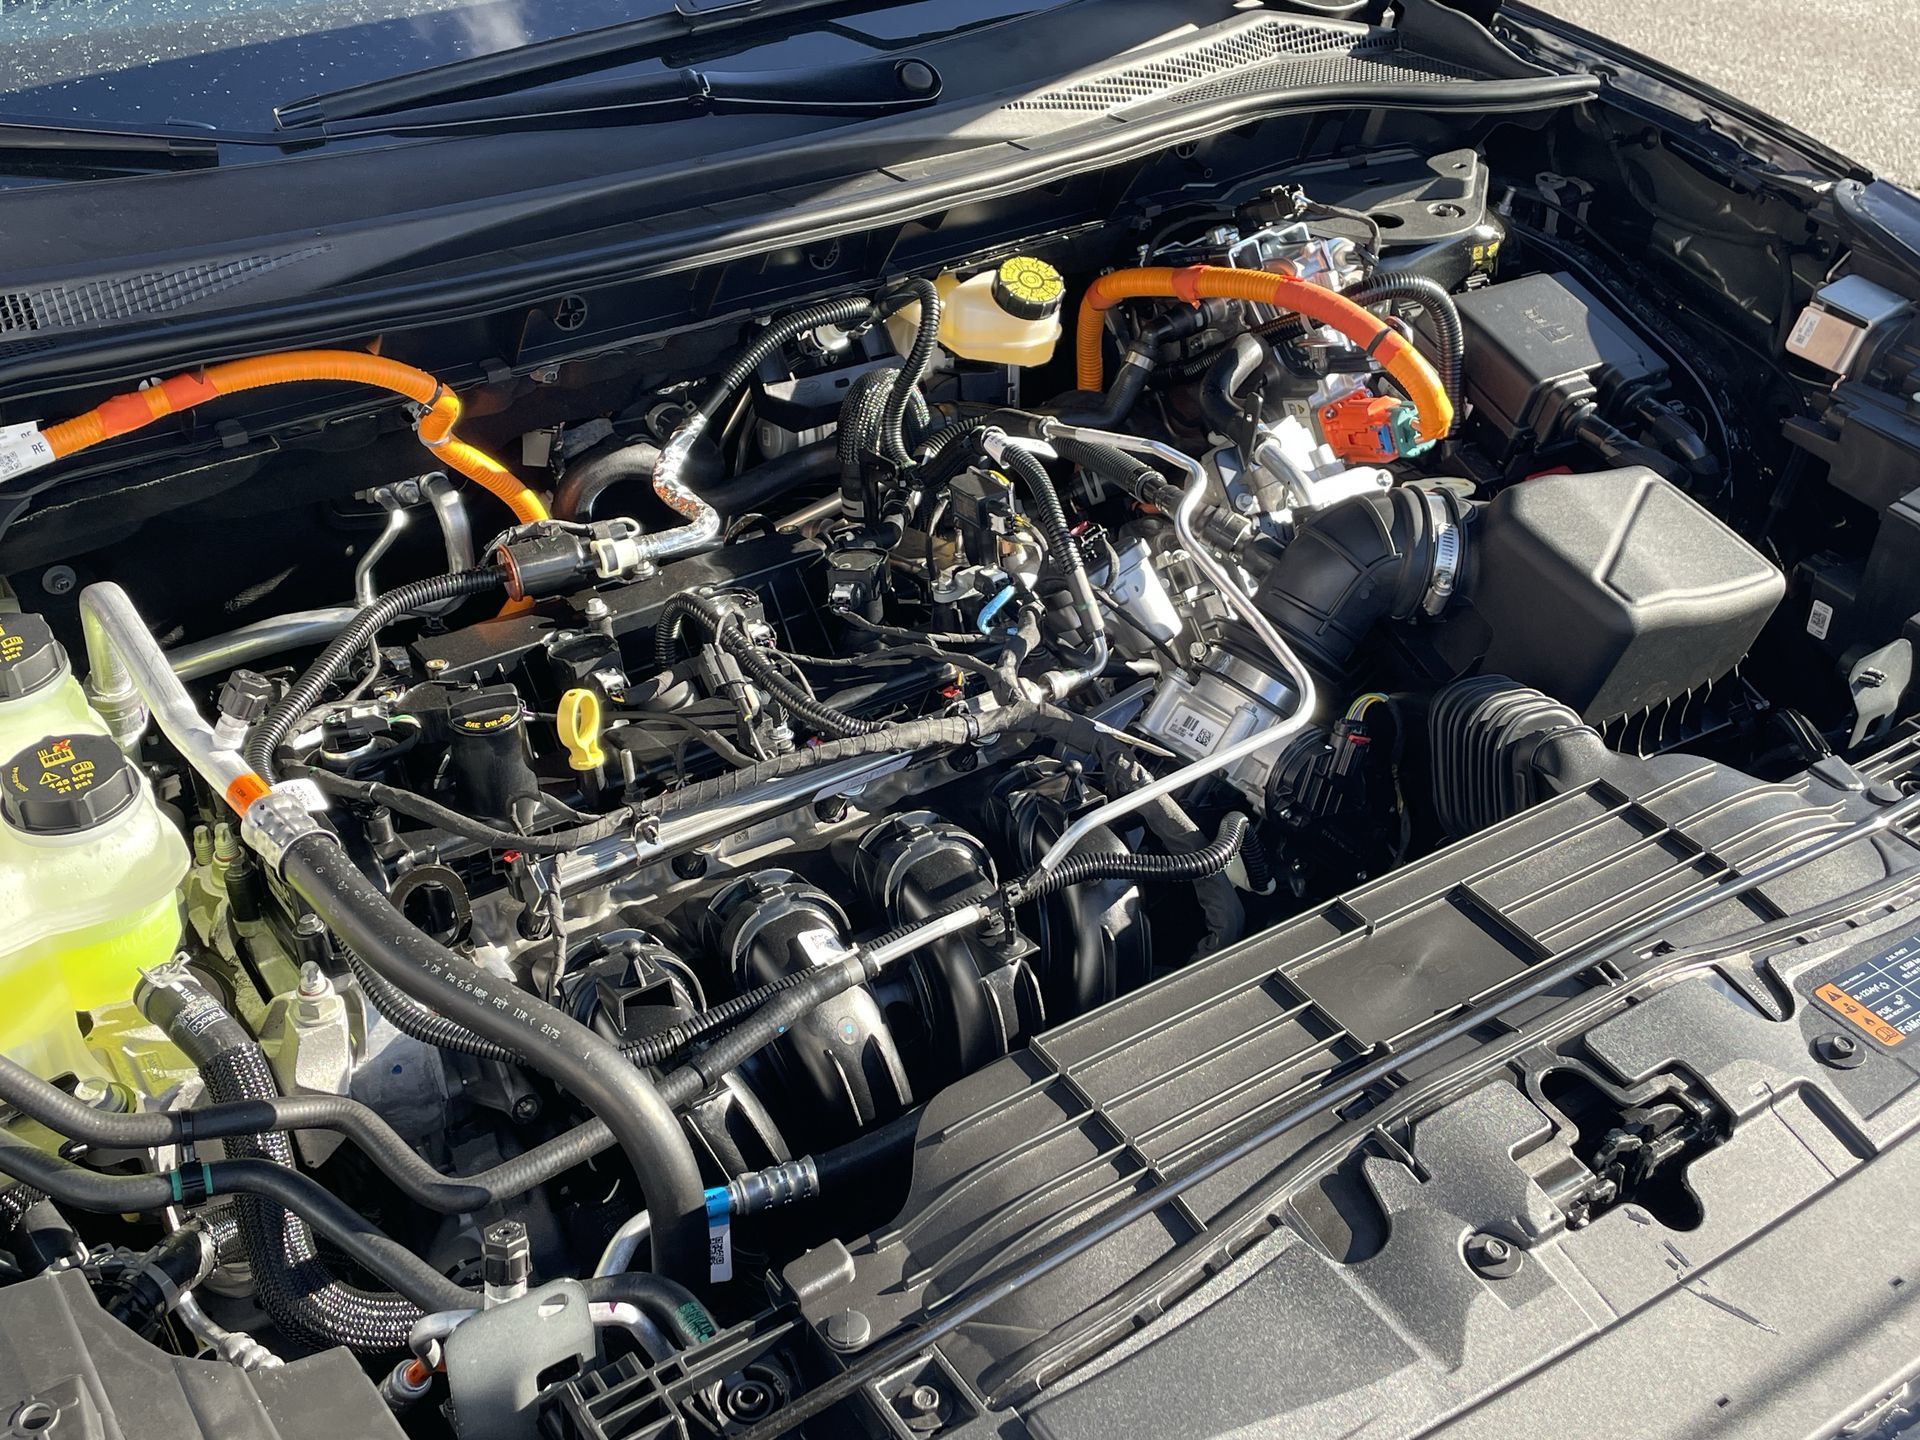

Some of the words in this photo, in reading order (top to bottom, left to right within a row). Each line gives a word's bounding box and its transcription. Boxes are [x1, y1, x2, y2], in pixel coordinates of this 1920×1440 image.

[31, 441, 46, 455] RE
[464, 721, 481, 729] SAE
[71, 772, 95, 782] kPa
[57, 785, 72, 794] 21
[1875, 1005, 1893, 1017] POE
[191, 1008, 227, 1032] FoMoCo
[540, 1023, 561, 1040] 2175
